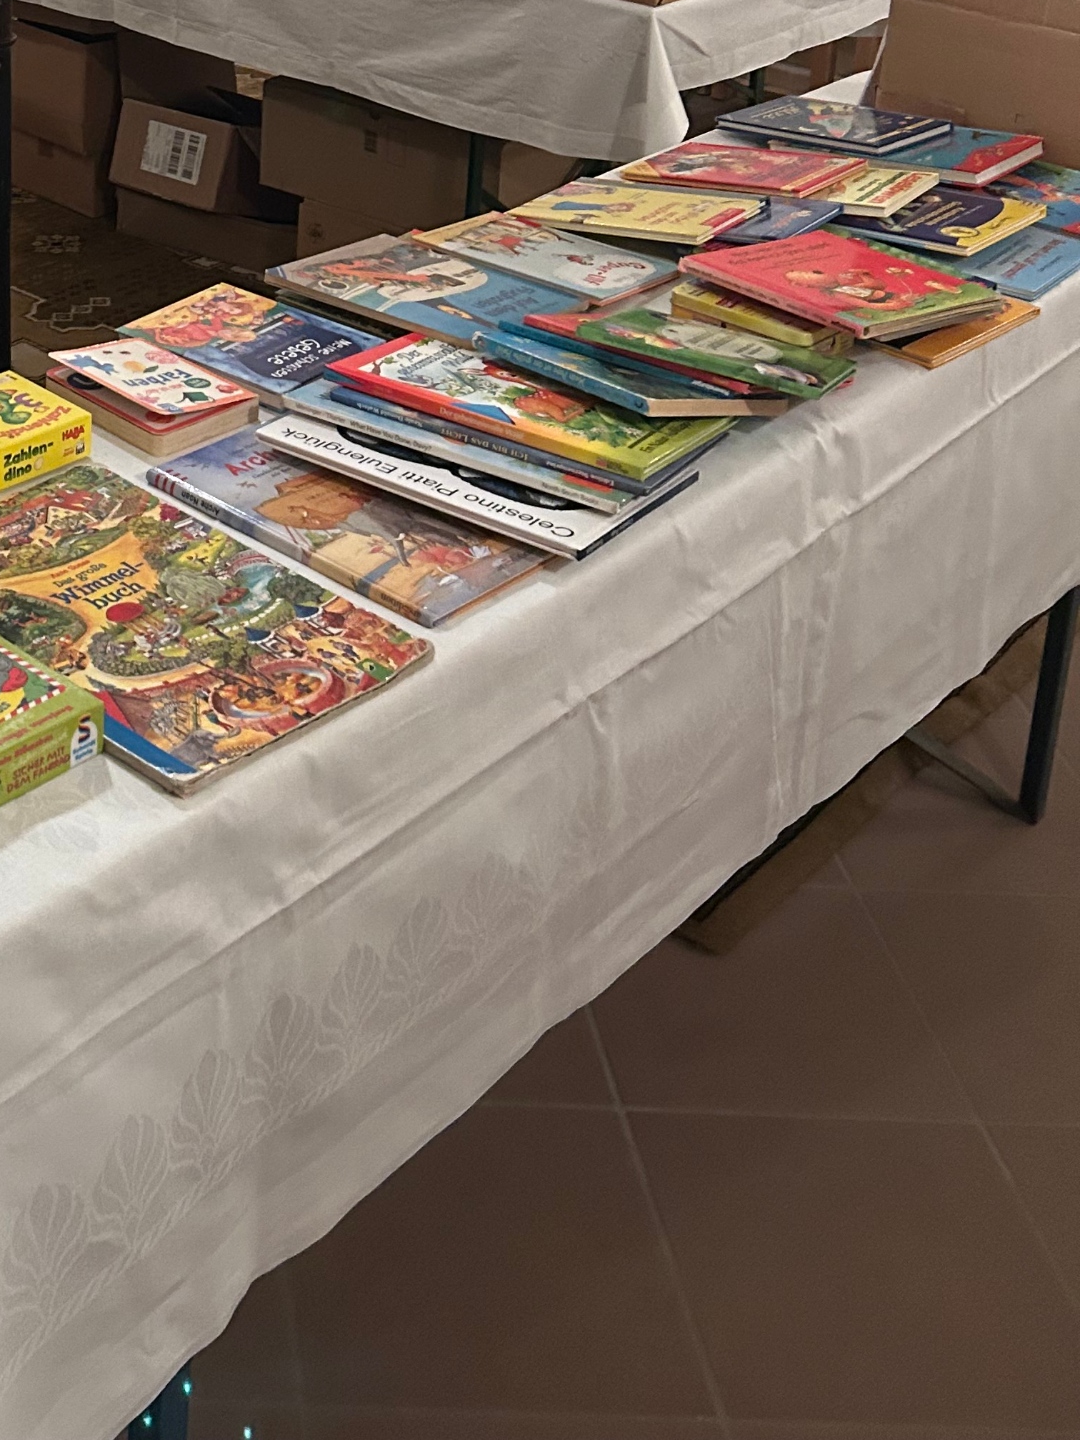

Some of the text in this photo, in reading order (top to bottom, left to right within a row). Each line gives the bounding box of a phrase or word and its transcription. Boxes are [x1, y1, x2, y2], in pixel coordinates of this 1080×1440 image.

[267, 338, 321, 366] Gebete
[123, 368, 193, 389] Farben
[61, 424, 85, 441] HABA
[3, 441, 54, 468] Zahlen-
[224, 448, 281, 476] Arch
[282, 426, 398, 474] Eulenglück
[3, 463, 32, 482] dino
[398, 470, 459, 497] Piatti
[463, 493, 575, 539] Celestino
[49, 561, 144, 604] Wimmel-
[75, 563, 107, 581] große
[82, 582, 146, 610] buch
